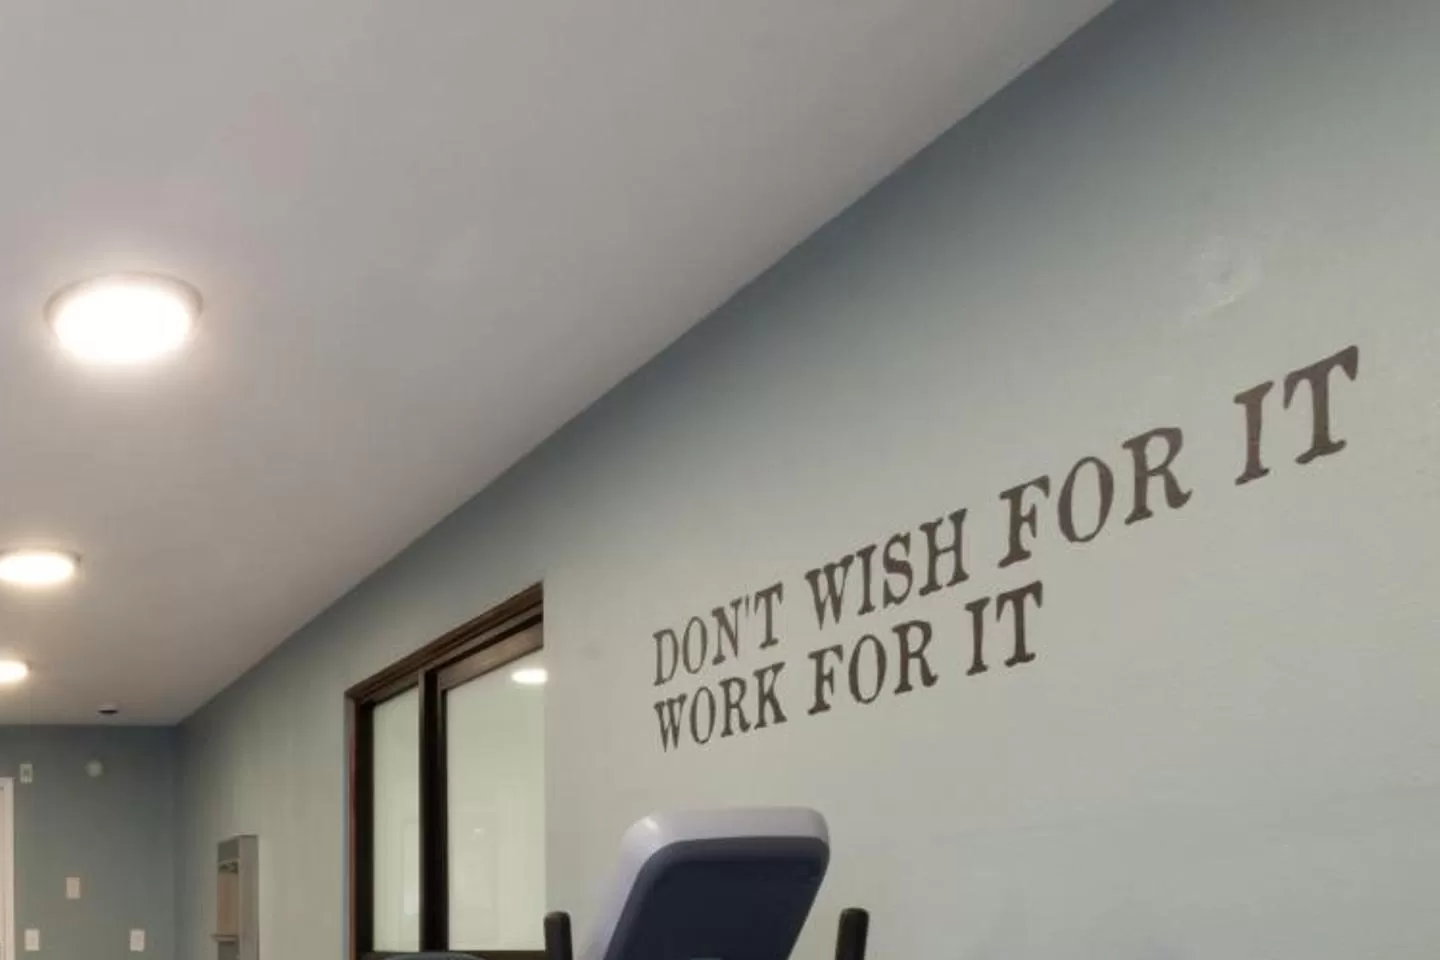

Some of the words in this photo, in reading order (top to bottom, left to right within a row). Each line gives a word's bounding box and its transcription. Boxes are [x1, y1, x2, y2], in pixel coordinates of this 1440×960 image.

[651, 580, 785, 688] DON'T
[803, 506, 971, 632] WISH
[996, 425, 1194, 570] FOR
[1231, 343, 1361, 487] IT
[651, 660, 789, 754] WORK
[806, 618, 941, 718] FOR
[962, 578, 1045, 678] IT
